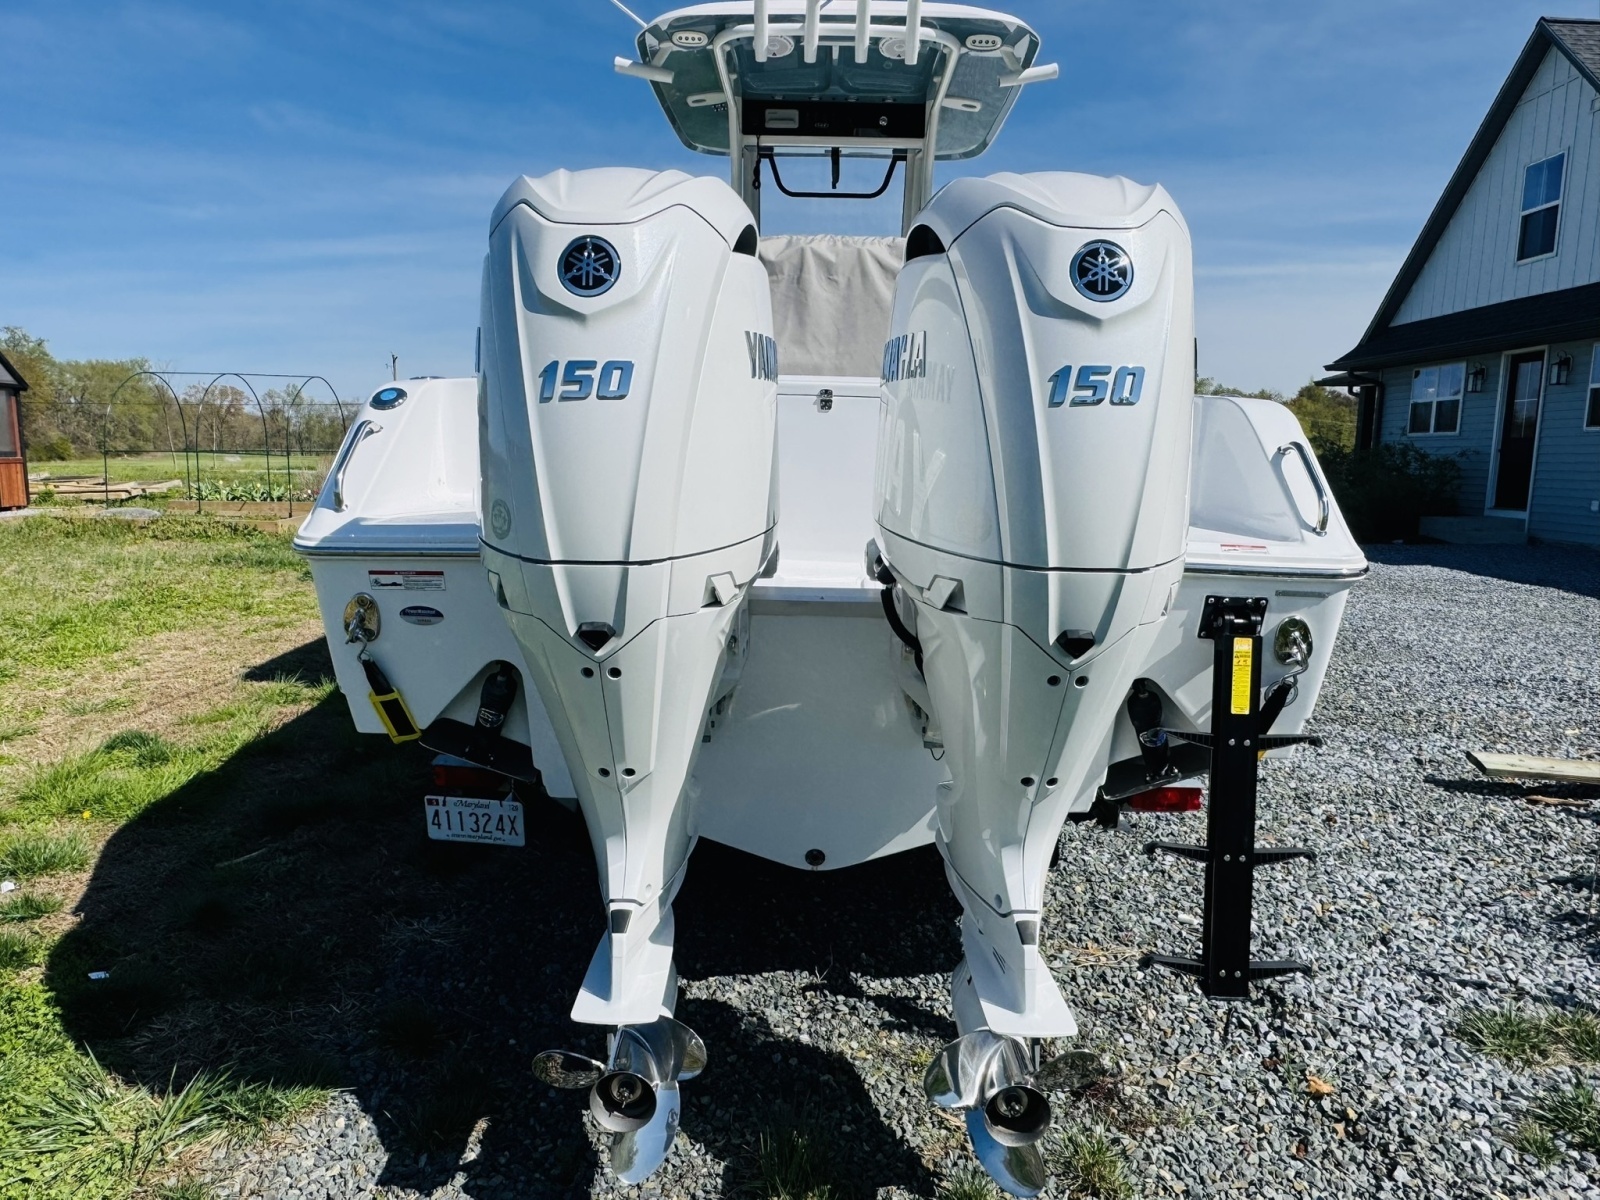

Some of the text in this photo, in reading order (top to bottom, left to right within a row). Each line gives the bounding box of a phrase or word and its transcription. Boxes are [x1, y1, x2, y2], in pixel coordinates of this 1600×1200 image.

[538, 360, 635, 403] 150
[1047, 365, 1146, 408] 150
[431, 809, 519, 836] 411324X
[454, 800, 490, 810] Maryland
